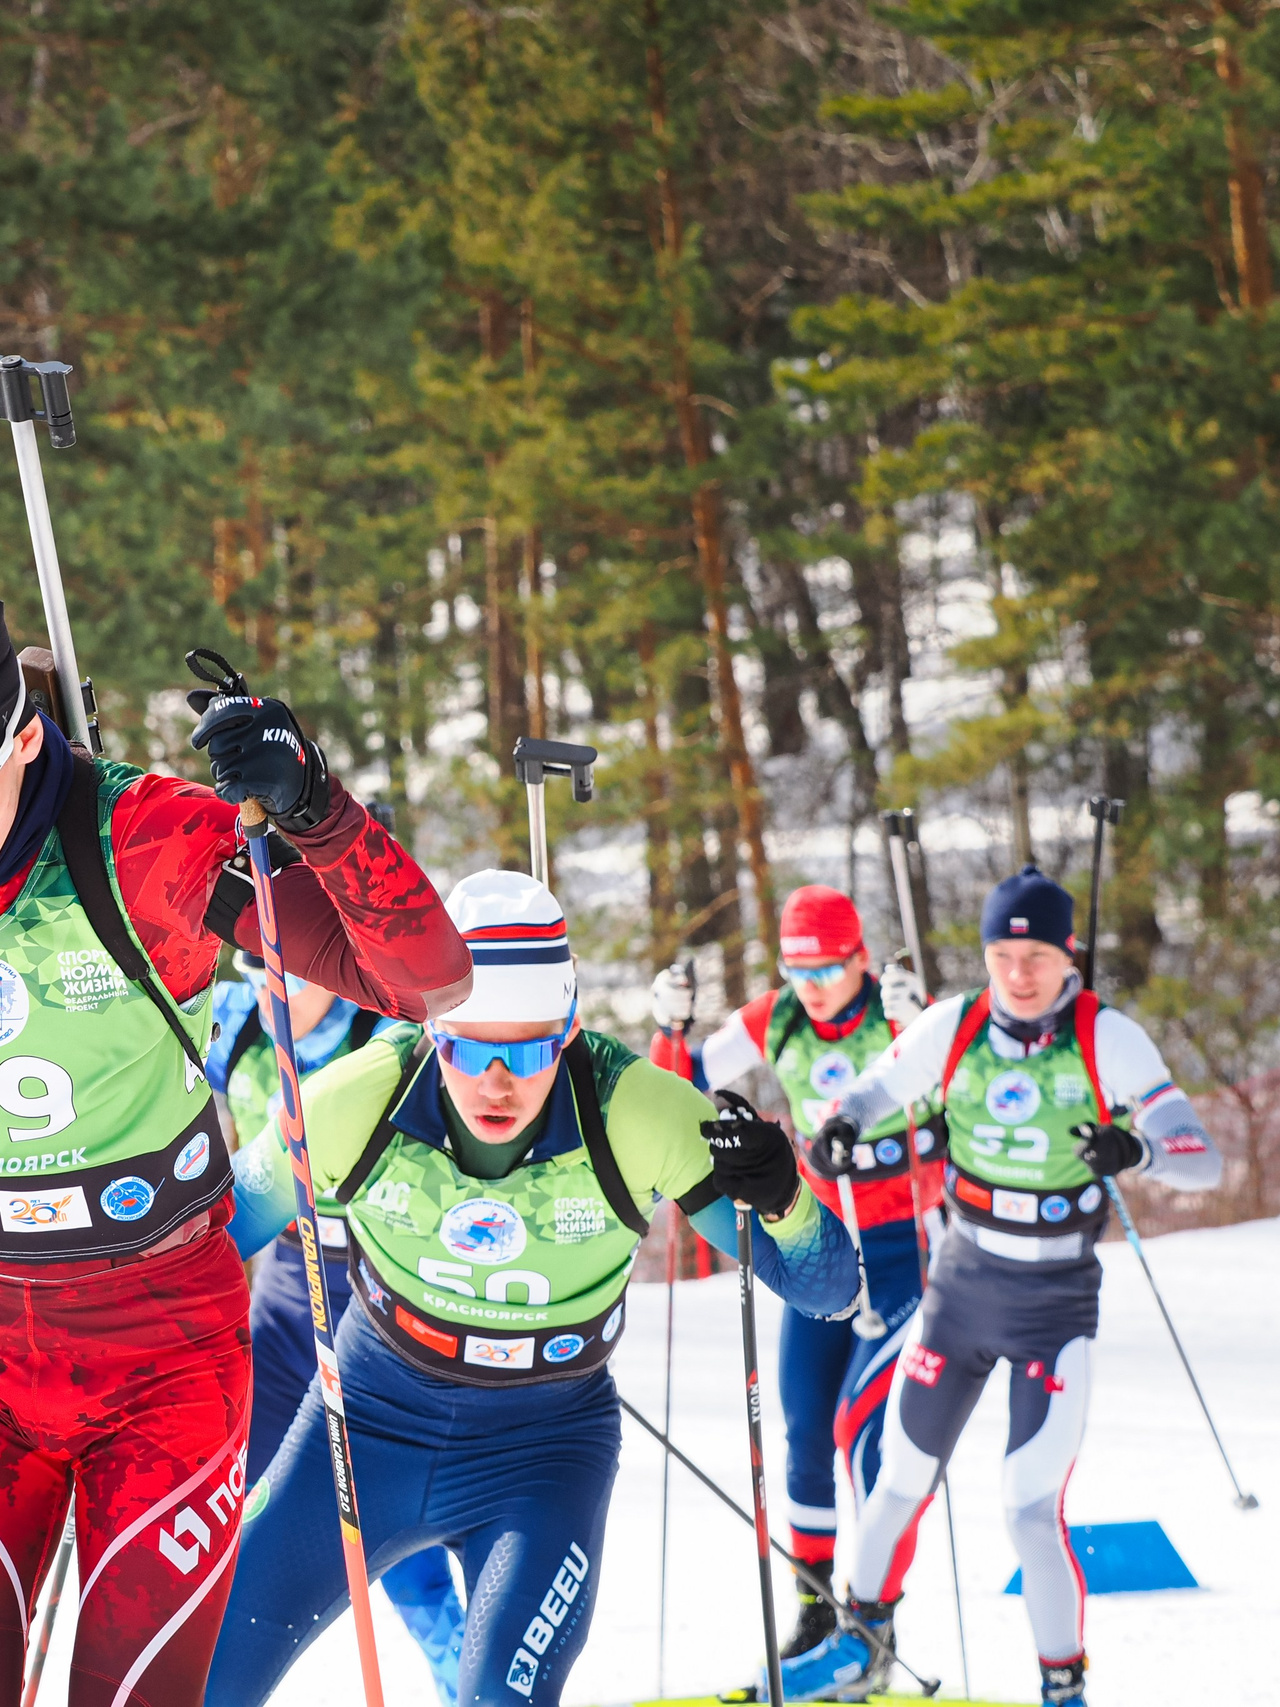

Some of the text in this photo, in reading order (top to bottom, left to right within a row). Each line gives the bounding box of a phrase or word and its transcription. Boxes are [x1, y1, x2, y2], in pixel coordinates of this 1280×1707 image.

[60, 963, 124, 980] НОРМА
[62, 976, 128, 995] ЖИЗНИ
[64, 990, 129, 1005] ФЕДЕРАЛЬНЫЙ
[65, 1002, 99, 1013] ПРОЕКТ
[555, 1219, 606, 1233] ЖИЗНИ
[299, 1216, 328, 1333] CHAMPION
[423, 1291, 548, 1322] КРАСНОЯРСК
[333, 1442, 348, 1492] CARBON
[340, 1491, 351, 1513] 2.0
[523, 1541, 590, 1656] BEEU
